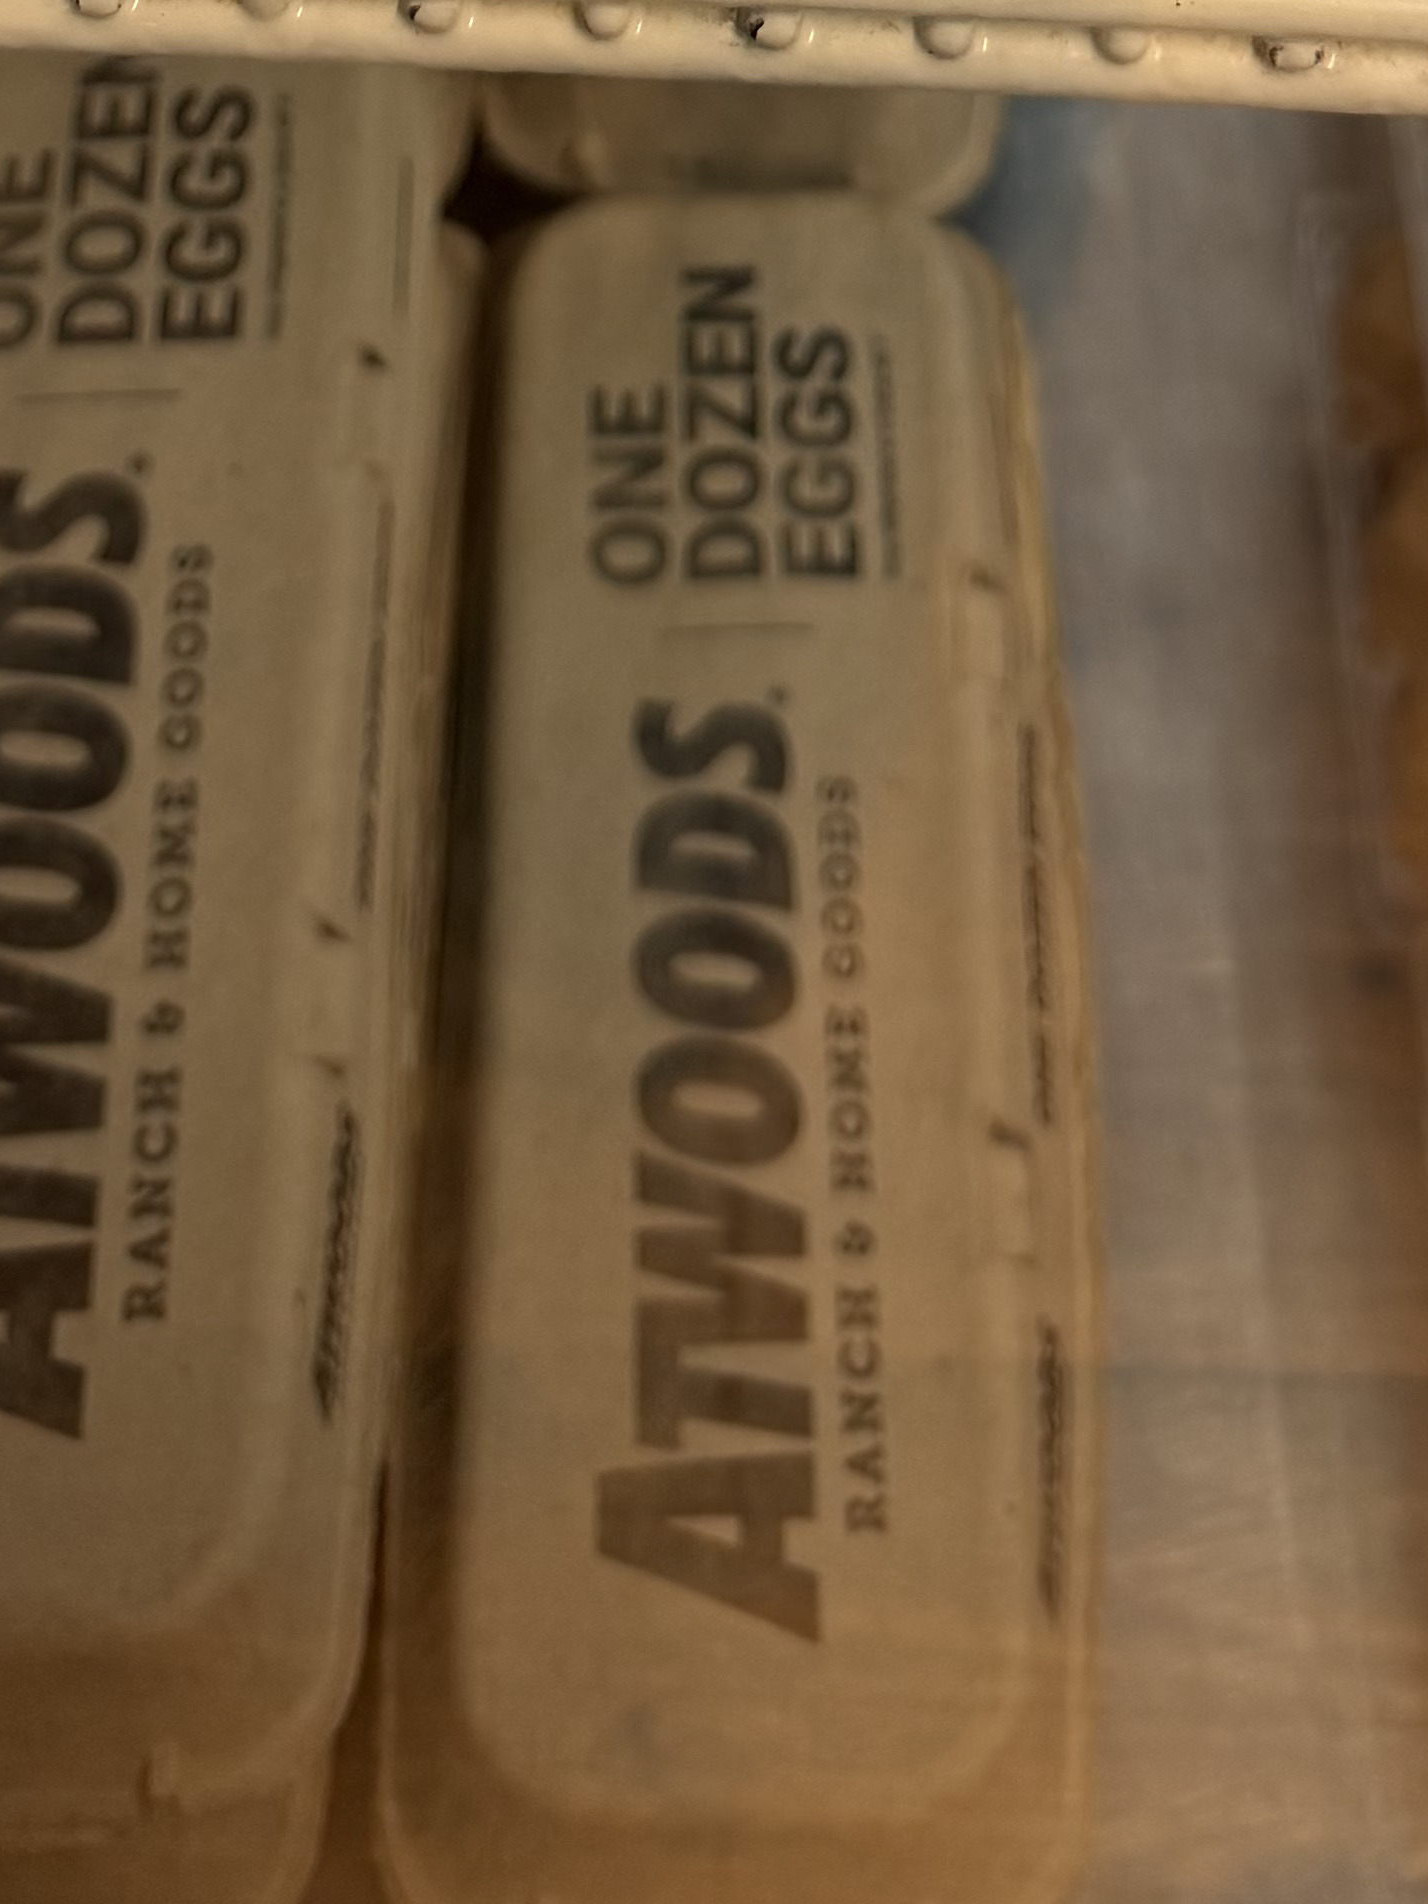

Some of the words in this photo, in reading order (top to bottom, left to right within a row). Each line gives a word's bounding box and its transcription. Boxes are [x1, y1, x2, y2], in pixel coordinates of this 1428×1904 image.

[159, 83, 257, 343] EGGS
[587, 383, 669, 588] ONE
[679, 264, 765, 581] DOZEN
[774, 323, 861, 580] EGGS
[159, 541, 215, 718] GOODS
[143, 782, 200, 977] HOME
[821, 777, 860, 953] GOODS
[142, 992, 183, 1033] &
[827, 1002, 866, 1196] HOME
[124, 1115, 183, 1329] RANCH
[596, 700, 822, 1642] ATWOODS
[839, 1220, 876, 1255] &
[844, 1288, 887, 1534] RANCH
